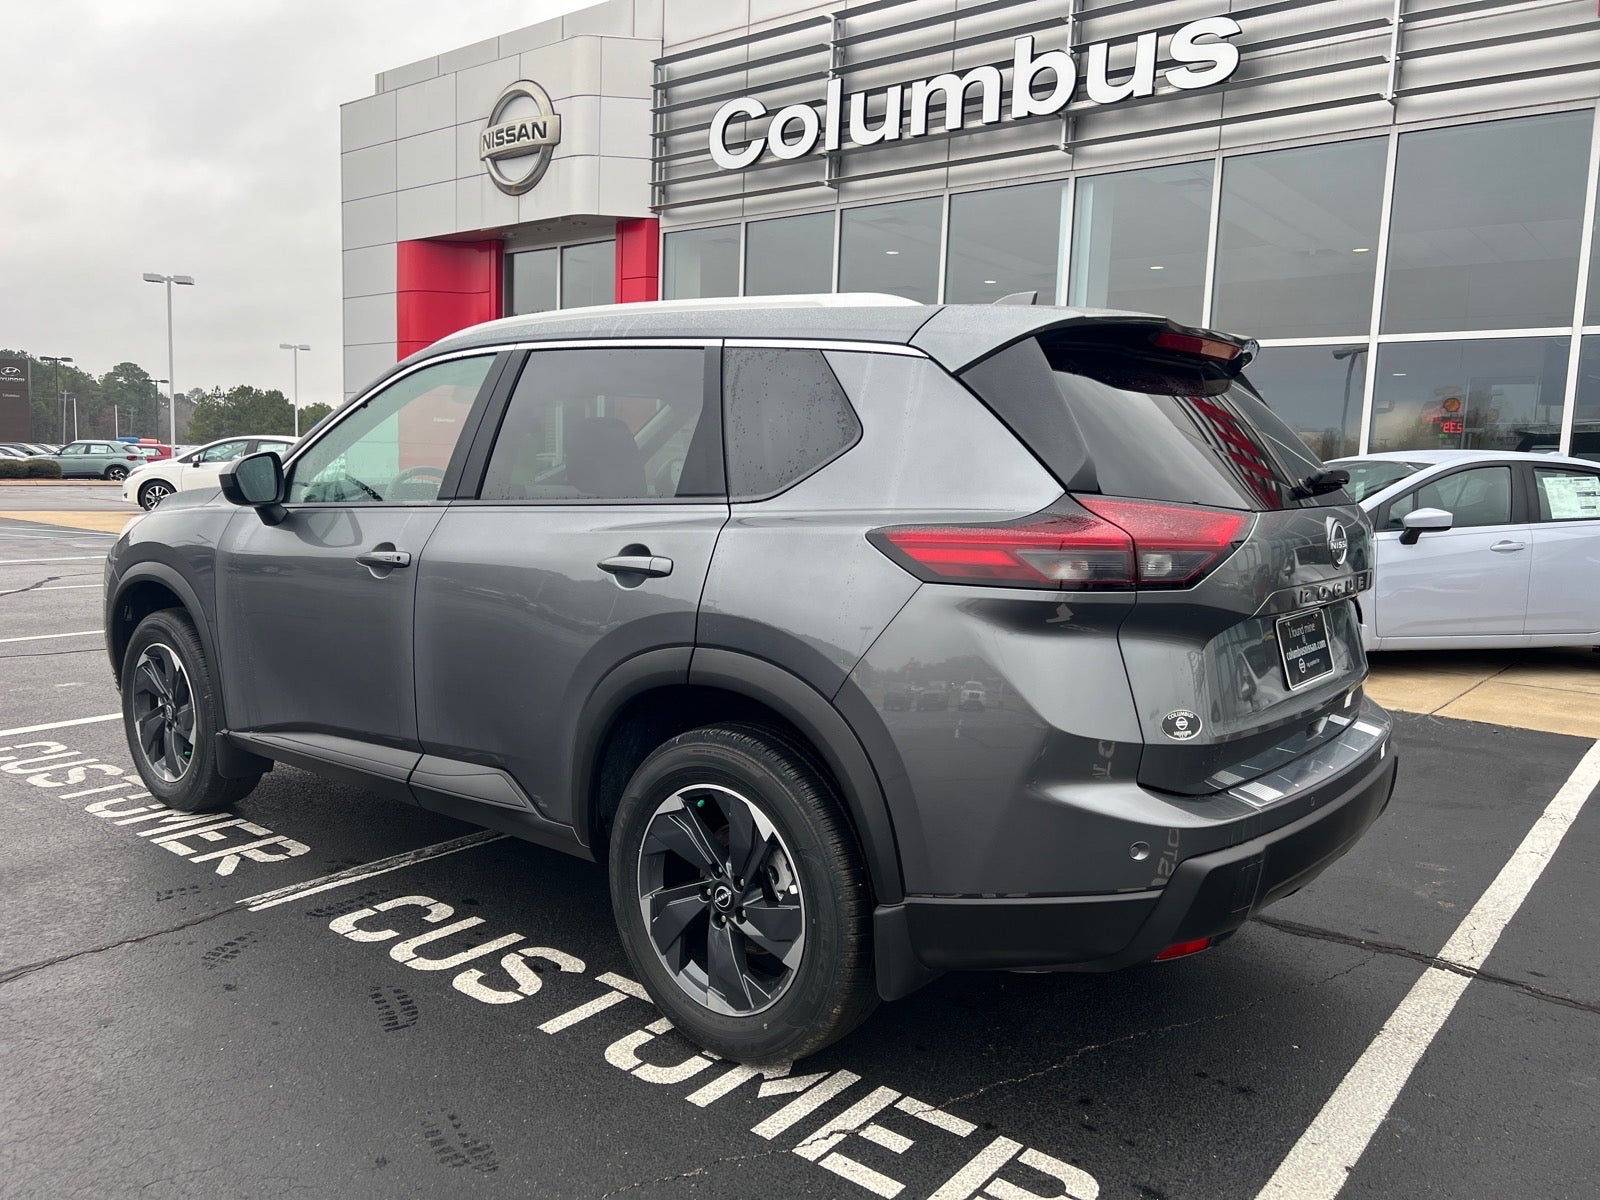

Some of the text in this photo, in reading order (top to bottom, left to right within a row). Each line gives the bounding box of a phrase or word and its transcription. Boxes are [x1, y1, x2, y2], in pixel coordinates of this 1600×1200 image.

[709, 16, 1243, 170] Columbus
[482, 120, 548, 153] NISSAN
[1301, 576, 1365, 603] ROGUE
